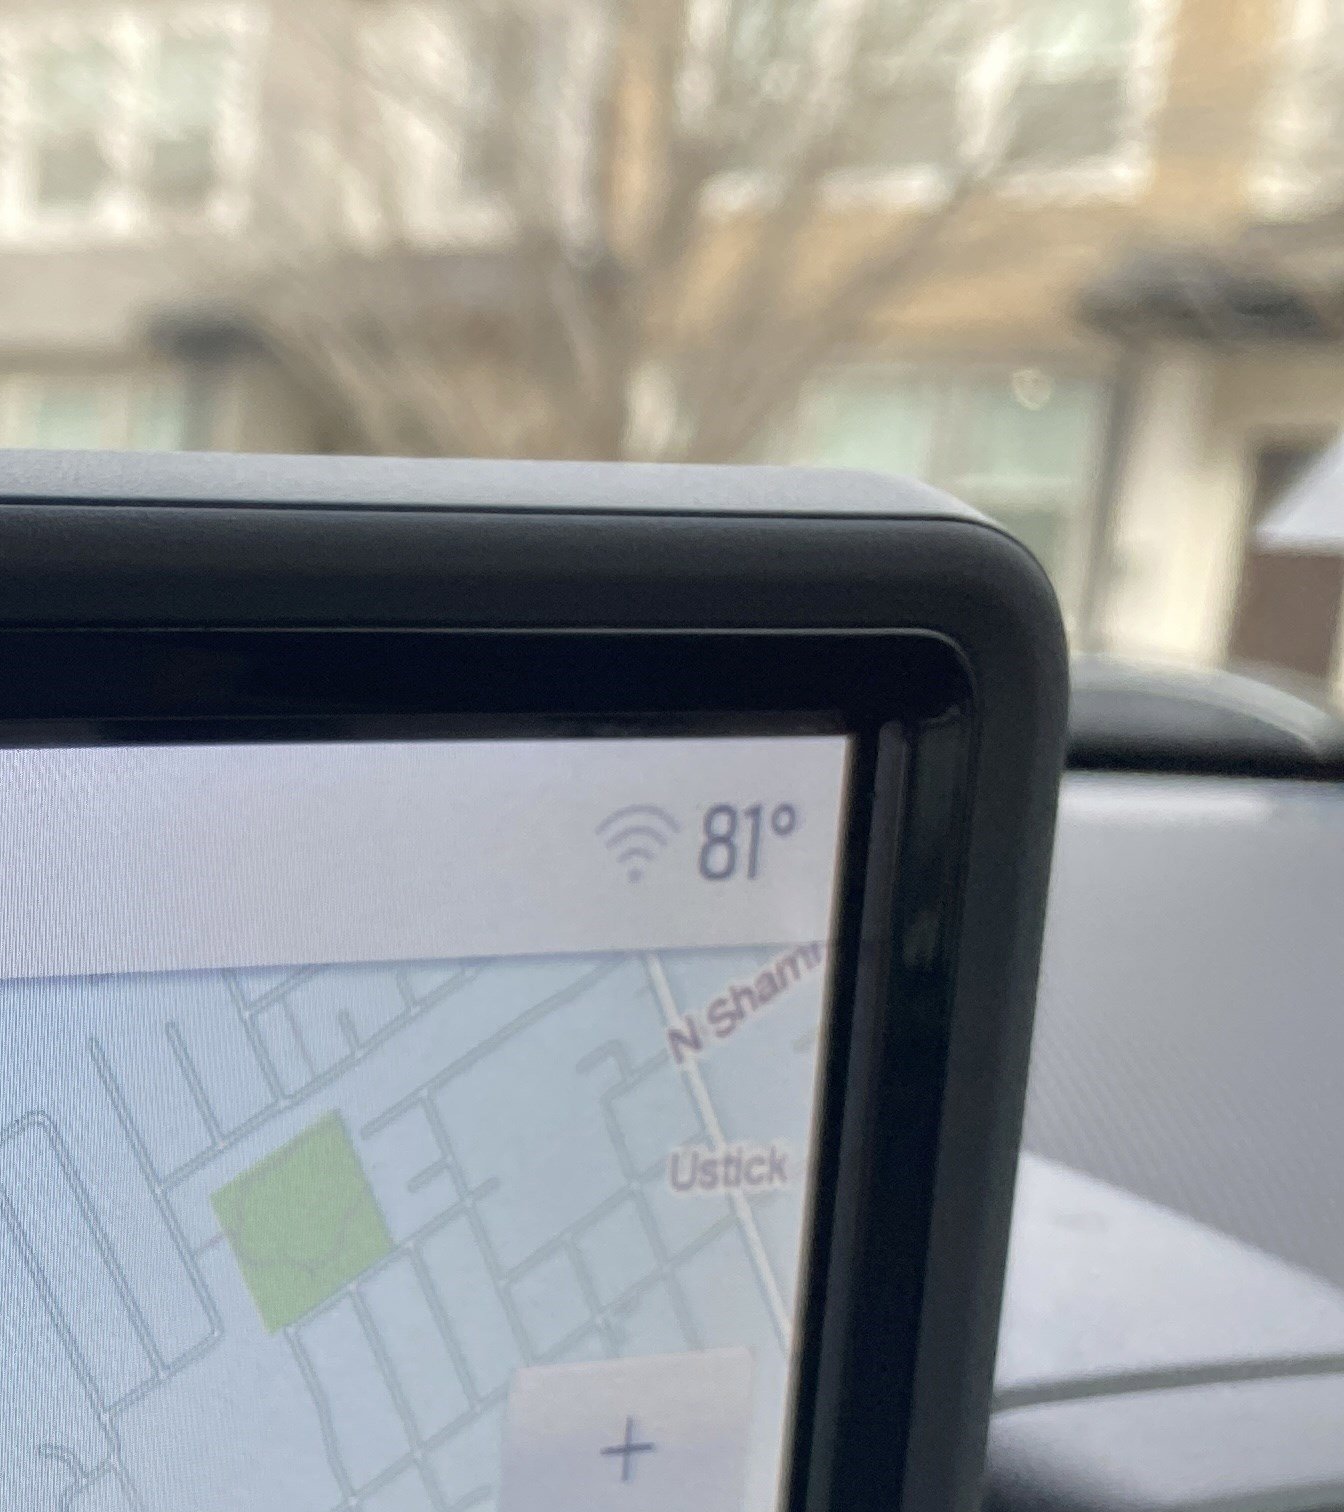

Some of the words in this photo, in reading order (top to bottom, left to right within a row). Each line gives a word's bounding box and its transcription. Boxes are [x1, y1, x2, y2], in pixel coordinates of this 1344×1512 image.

[698, 804, 799, 880] 81°
[667, 1016, 703, 1065] N
[668, 1144, 788, 1192] Ustick
